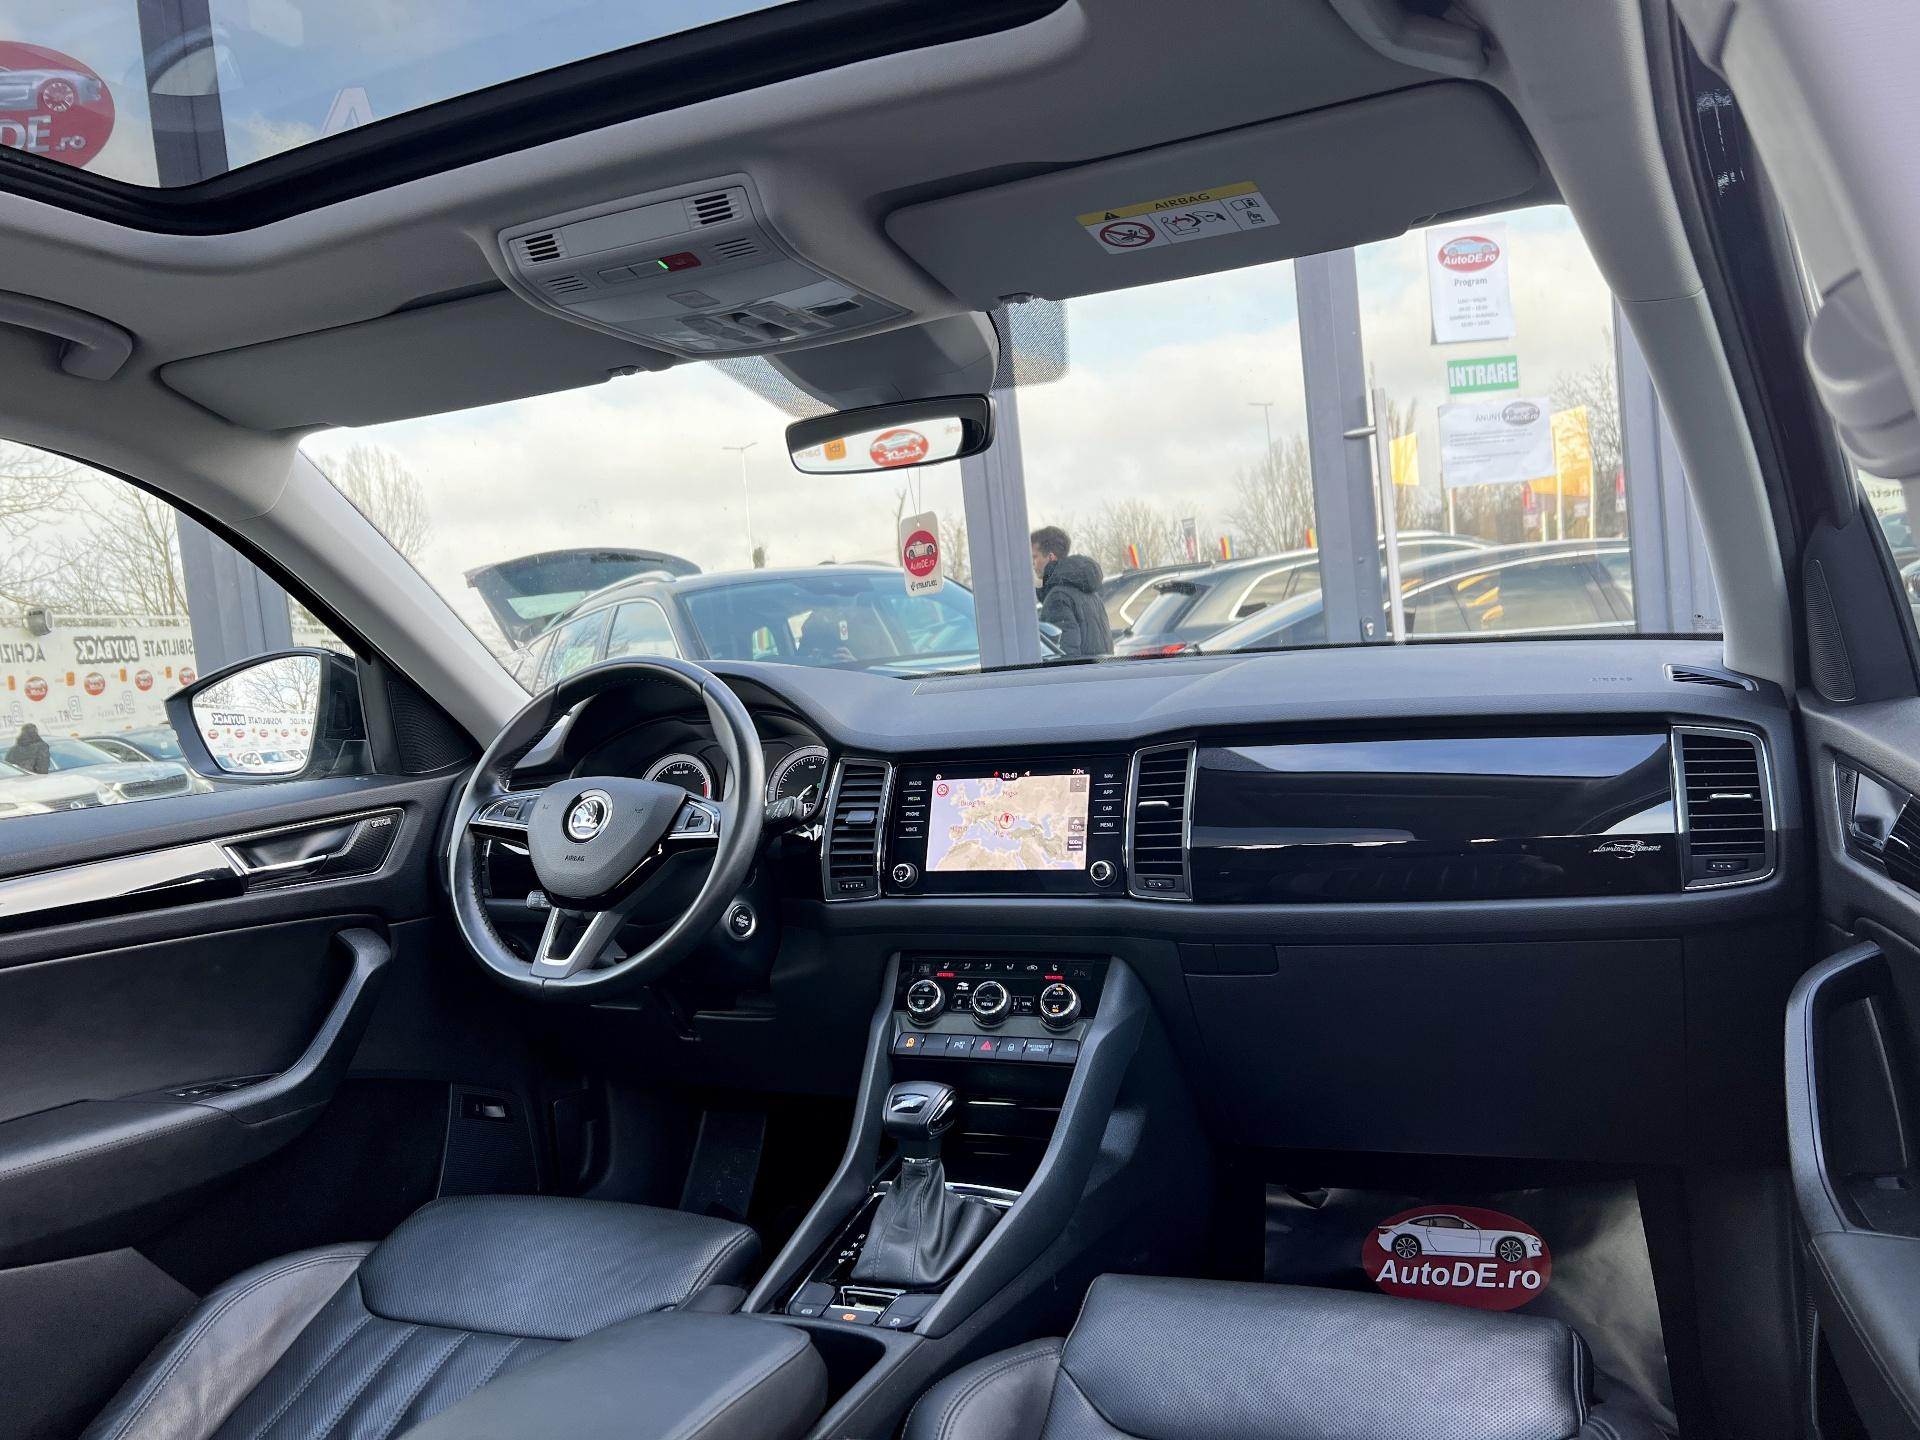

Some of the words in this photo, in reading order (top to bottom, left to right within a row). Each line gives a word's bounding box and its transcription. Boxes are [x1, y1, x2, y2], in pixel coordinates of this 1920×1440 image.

[1154, 192, 1211, 210] AIRBAG
[1443, 252, 1497, 266] AutoDE.ro
[1454, 277, 1488, 288] Program
[1448, 361, 1517, 388] INTRARE
[1375, 1259, 1541, 1290] AutoDE.ro
